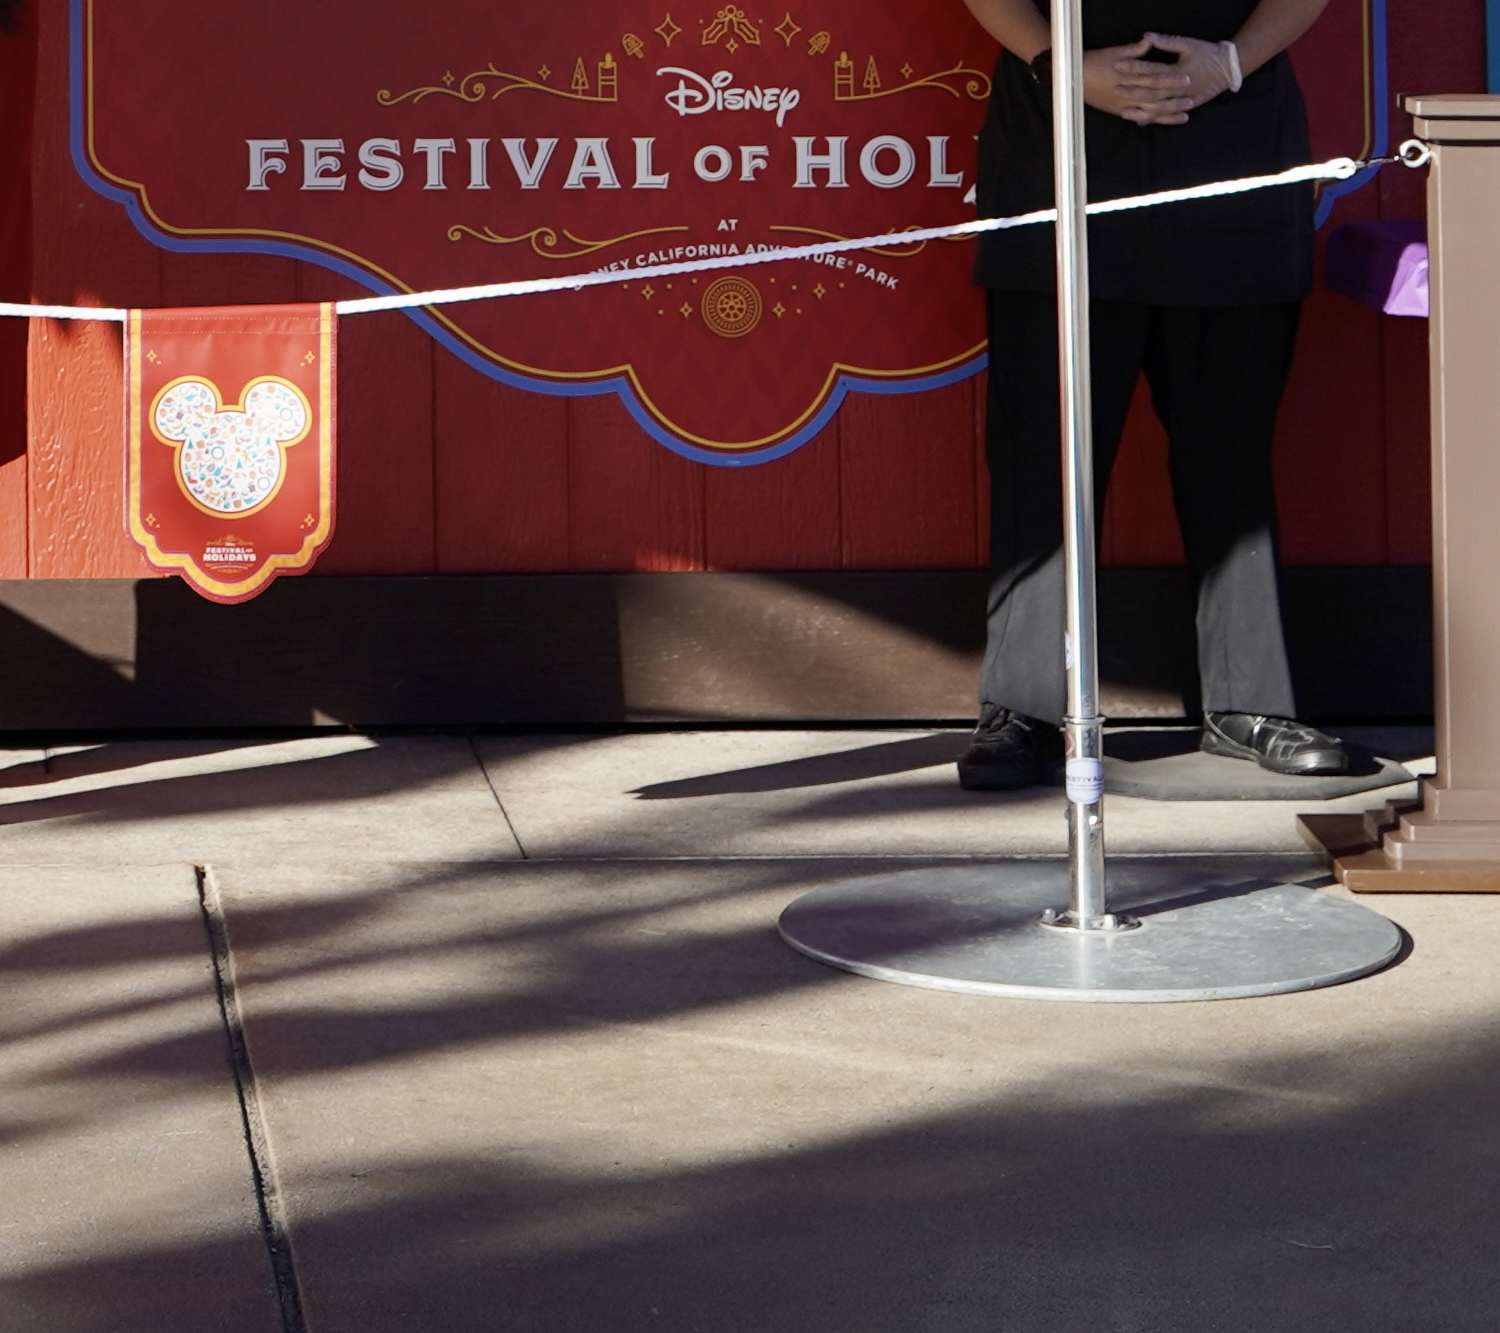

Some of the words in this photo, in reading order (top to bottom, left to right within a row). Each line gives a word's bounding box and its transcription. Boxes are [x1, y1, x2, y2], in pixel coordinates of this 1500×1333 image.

[656, 66, 801, 128] Disney
[244, 137, 670, 191] FESTIVAL
[693, 144, 770, 183] OF
[717, 218, 739, 232] AT
[635, 243, 739, 268] CALIFORNIA
[855, 263, 900, 291] PARK
